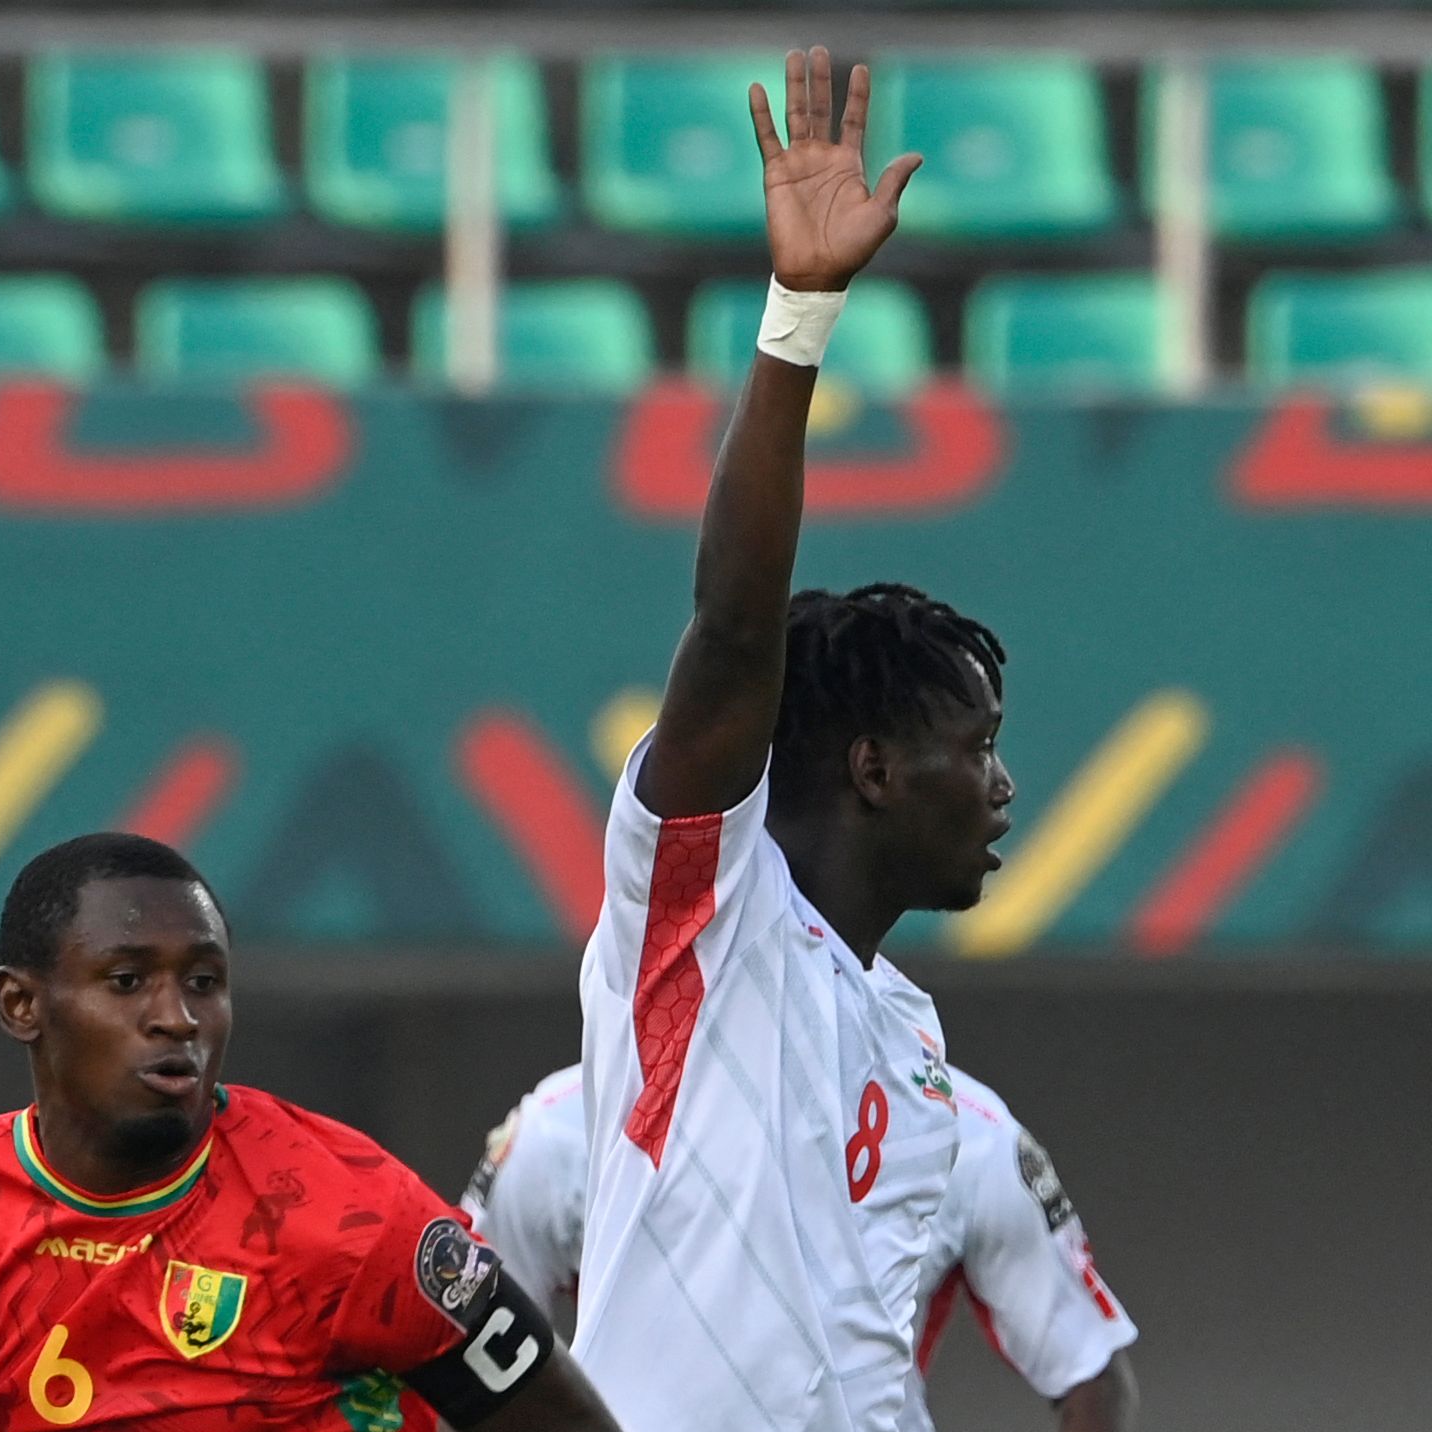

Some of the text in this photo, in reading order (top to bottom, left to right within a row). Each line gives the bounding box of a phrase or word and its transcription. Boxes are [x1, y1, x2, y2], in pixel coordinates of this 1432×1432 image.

[847, 1081, 889, 1202] 8
[28, 1324, 94, 1425] 6
[463, 1306, 540, 1393] C
